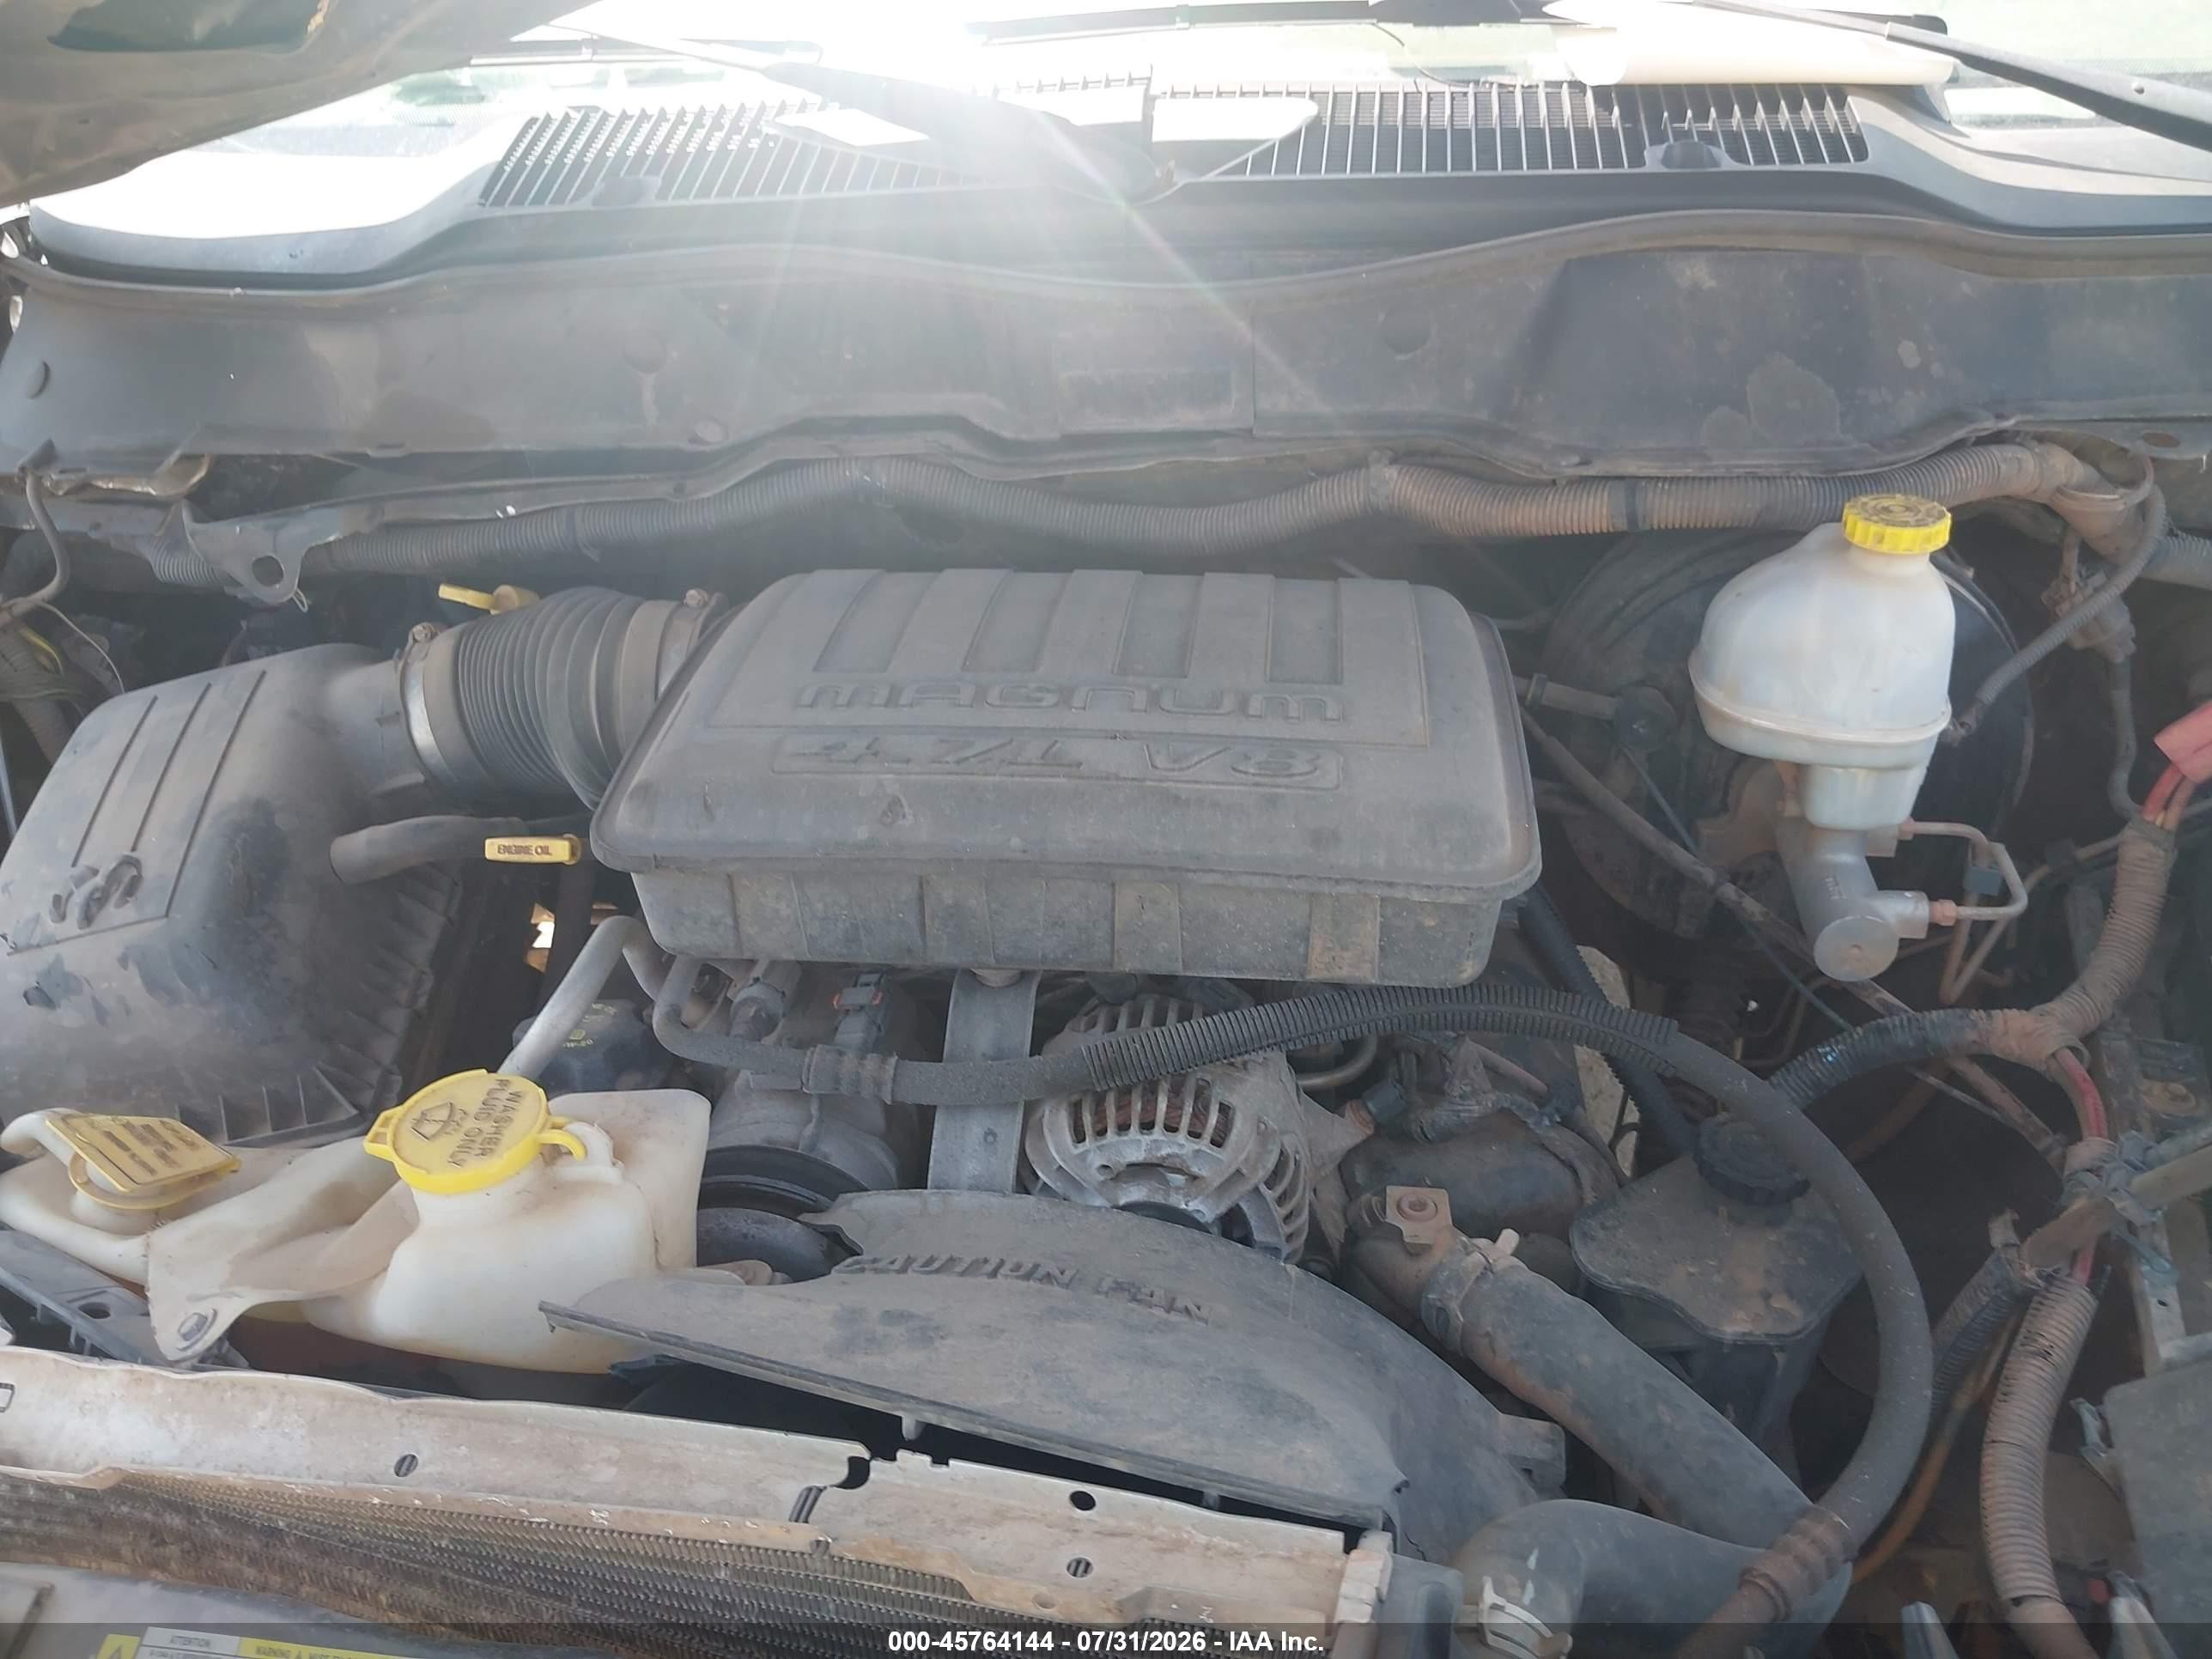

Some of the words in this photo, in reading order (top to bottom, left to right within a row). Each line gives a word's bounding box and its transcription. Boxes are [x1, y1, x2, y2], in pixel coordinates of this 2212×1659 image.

[797, 684, 1343, 722] MAGNUM
[1142, 741, 1320, 778] V8
[497, 844, 532, 855] ENGINE
[534, 845, 553, 856] OIL
[473, 1079, 511, 1121] FLUID
[473, 1090, 523, 1158] WASHER
[447, 1127, 482, 1169] ONLY
[833, 1254, 1079, 1288] CAUTION
[1097, 1277, 1209, 1325] FAN
